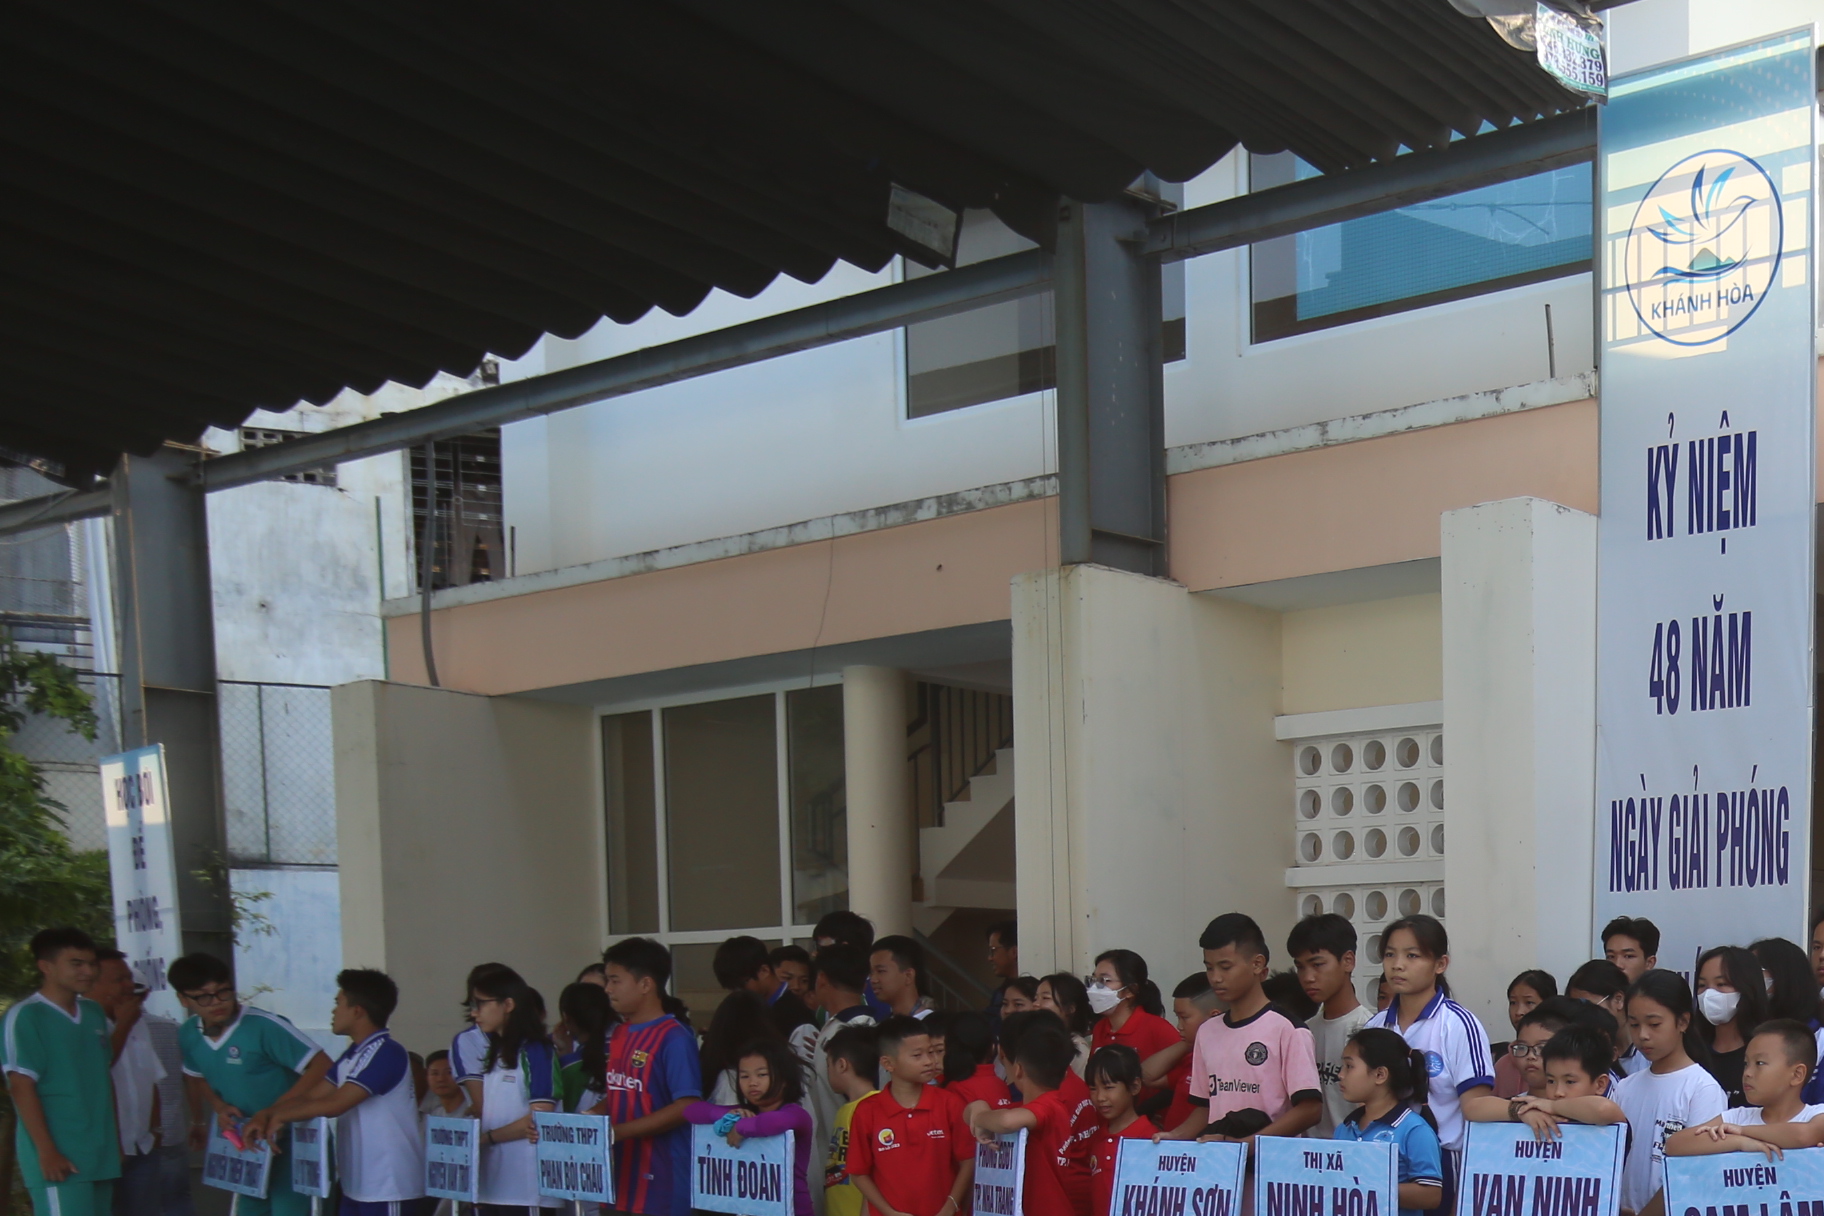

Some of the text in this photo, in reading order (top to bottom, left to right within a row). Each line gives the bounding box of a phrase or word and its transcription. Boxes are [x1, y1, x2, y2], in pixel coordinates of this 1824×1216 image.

[1652, 282, 1754, 320] KHÁNH HÒA
[1647, 409, 1757, 555] KỶ NIỆM
[1649, 593, 1751, 715] 48 NĂM
[1610, 764, 1790, 893] NGÀY GIẢI PHÓNG
[541, 1123, 598, 1145] TRƯỜNG THPT
[541, 1159, 563, 1190] PHAN
[580, 1157, 603, 1194] CHÂU
[698, 1143, 781, 1202] TỈNH ĐOÀN
[1158, 1153, 1196, 1175] HUYỆN
[1303, 1151, 1343, 1173] THỊ XÃ
[1723, 1163, 1777, 1189] HUYỆN
